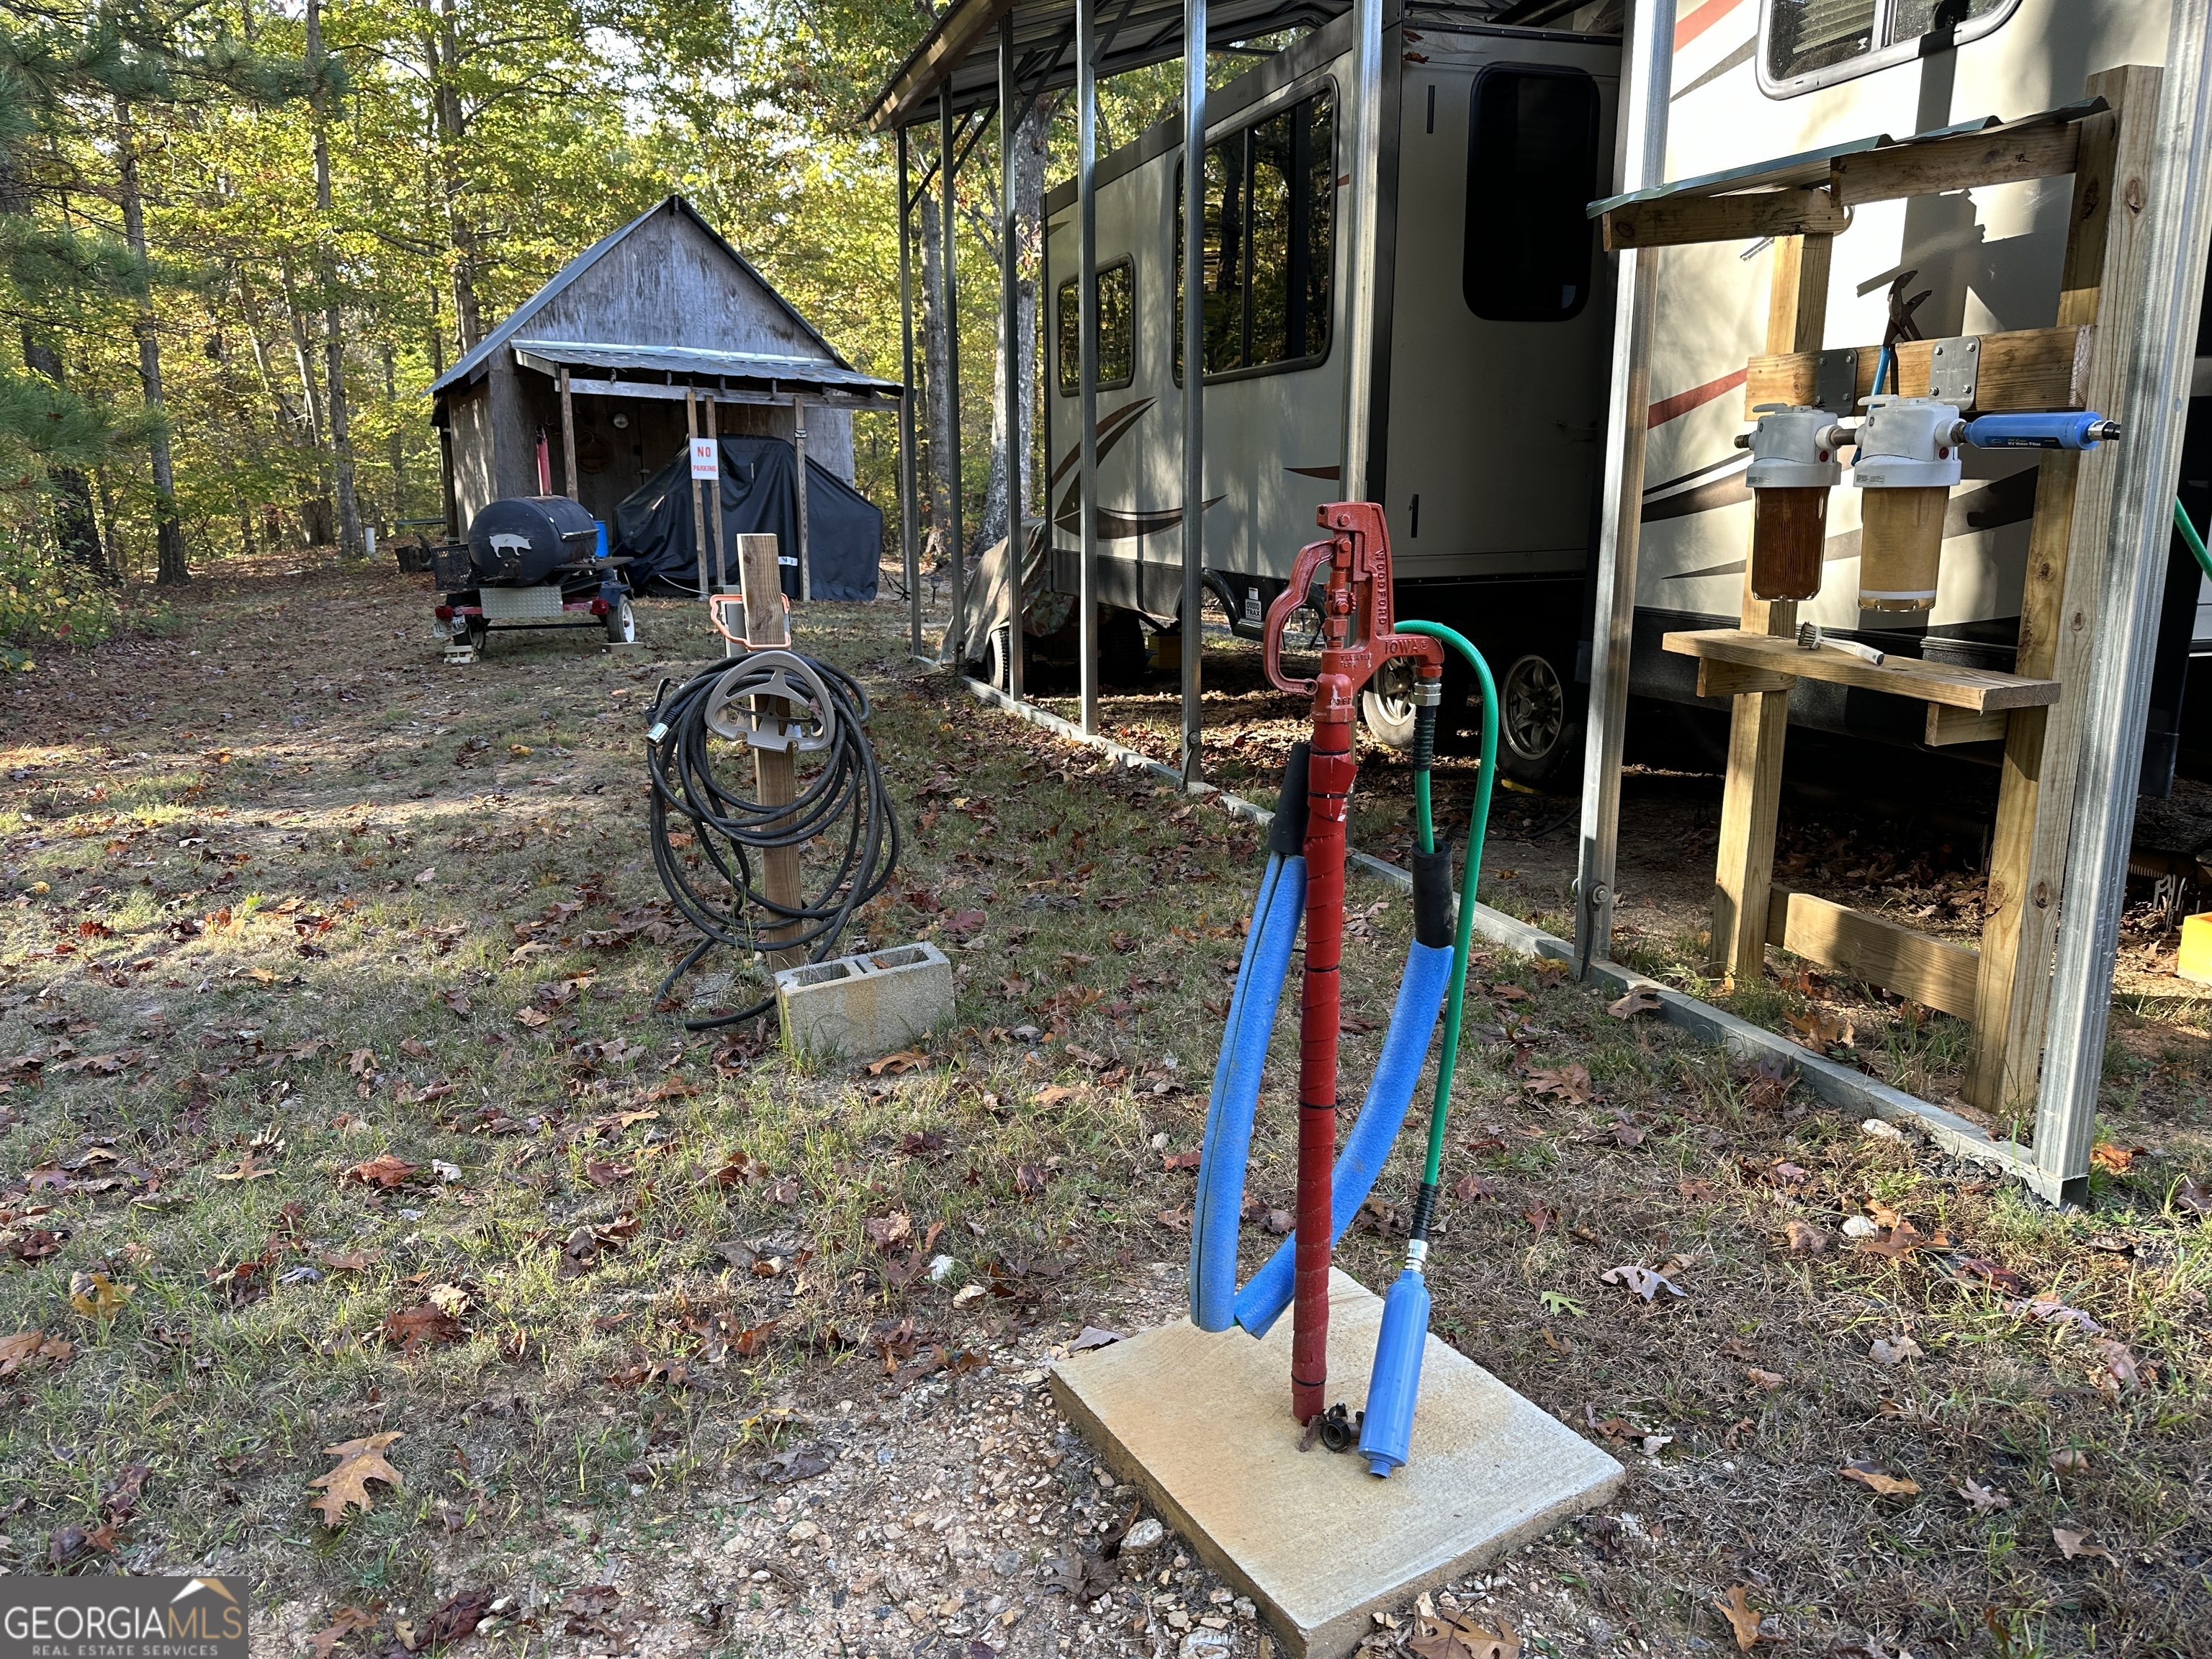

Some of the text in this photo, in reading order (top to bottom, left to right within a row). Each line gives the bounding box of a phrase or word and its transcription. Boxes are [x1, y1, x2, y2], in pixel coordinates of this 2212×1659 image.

[697, 446, 711, 457] NO
[1375, 549, 1388, 626] WOODFORD
[1246, 608, 1260, 616] TRAX
[1384, 639, 1419, 655] IOWA
